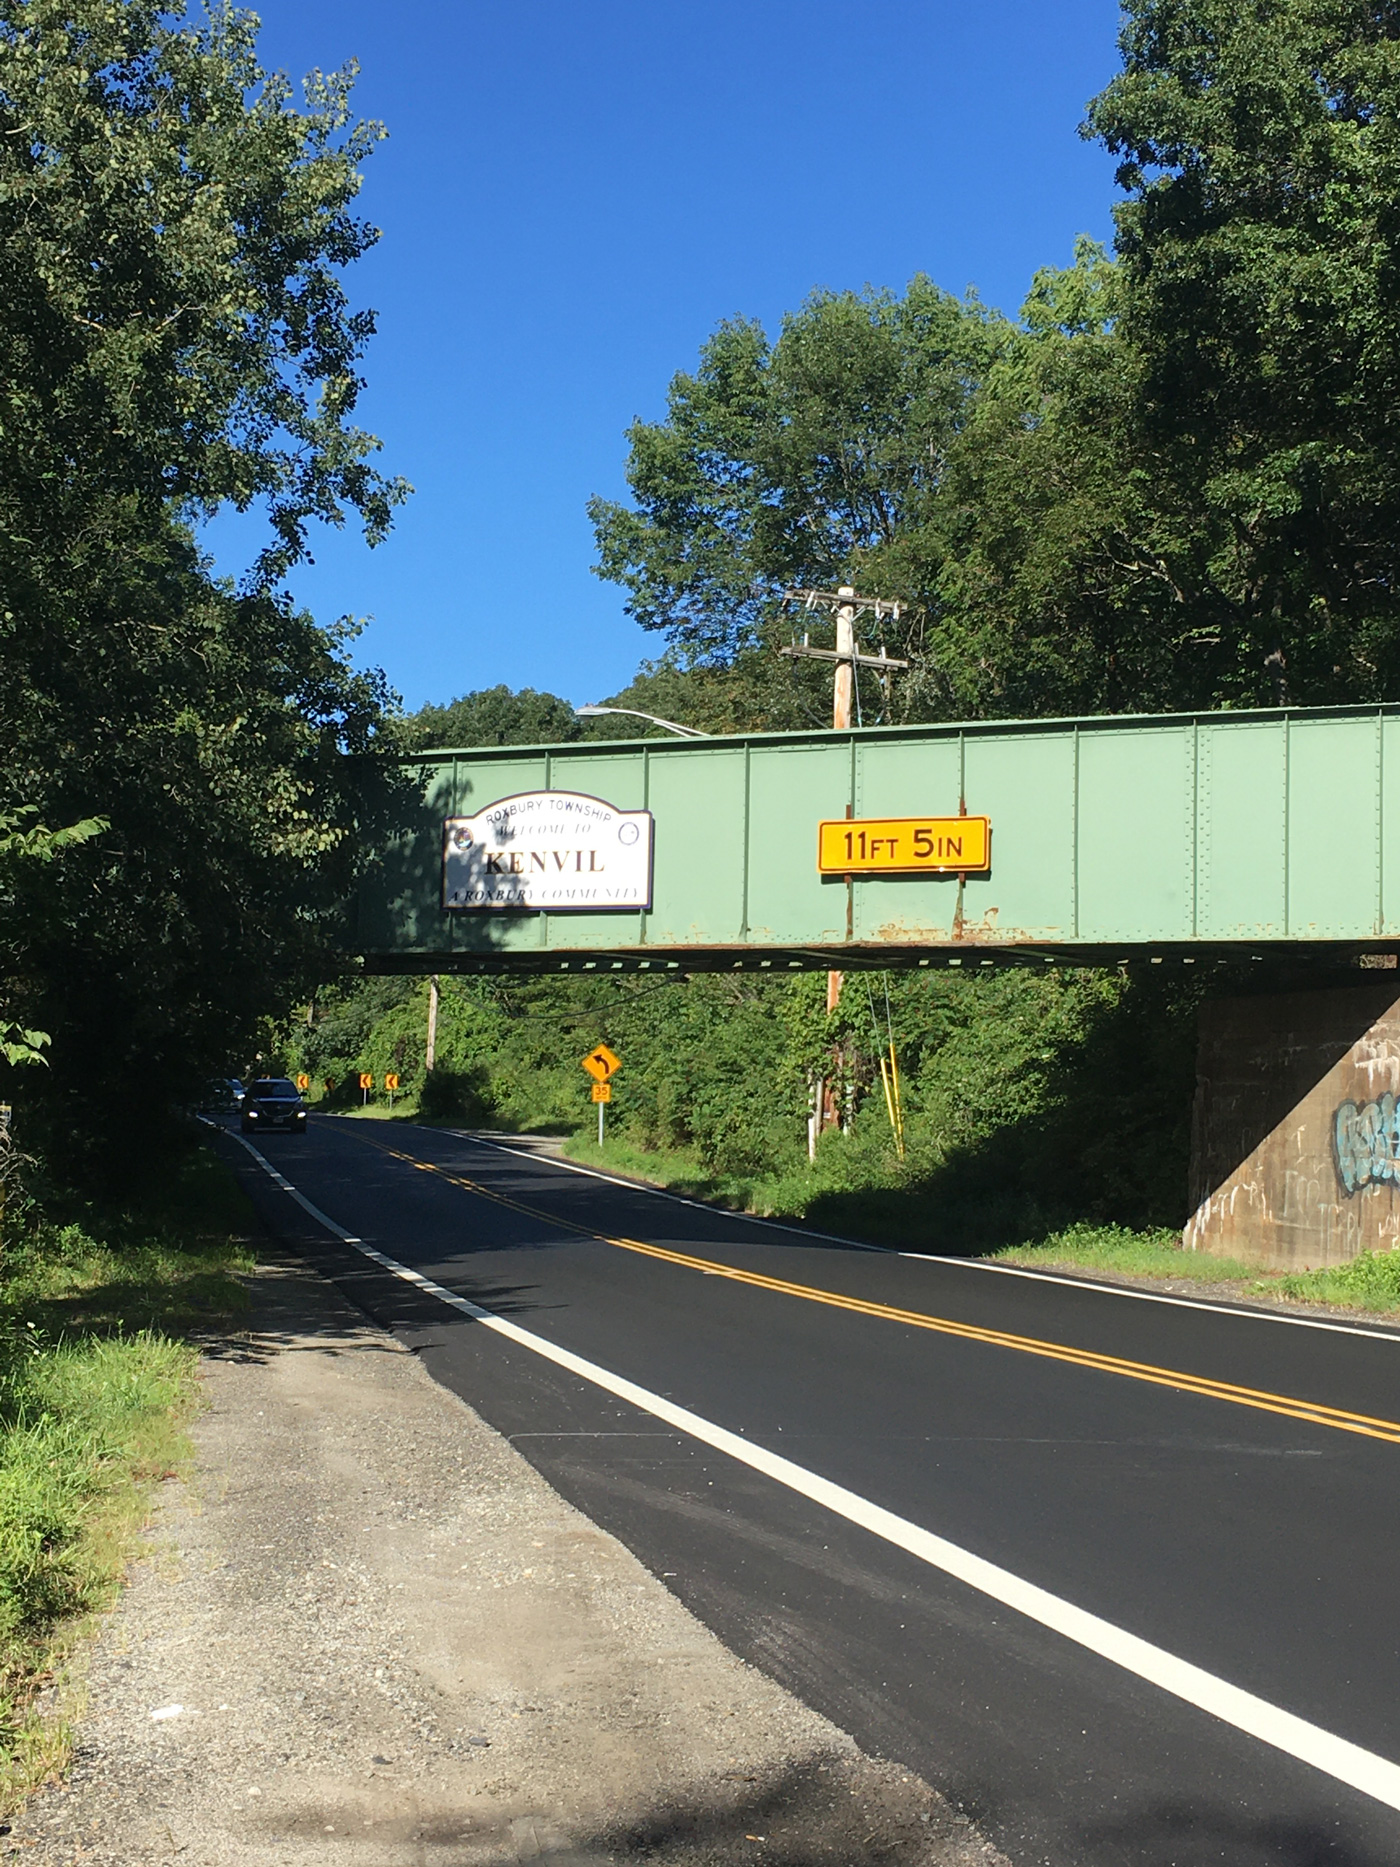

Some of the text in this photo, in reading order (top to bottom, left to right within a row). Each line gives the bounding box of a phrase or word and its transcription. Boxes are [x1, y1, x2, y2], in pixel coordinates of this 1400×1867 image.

[486, 799, 612, 825] ROXBURY TOWNSHIP
[499, 823, 592, 837] WELCOME TO
[484, 850, 605, 875] KENVIL
[449, 887, 638, 902] A ROXBURY COMMUNITY
[595, 1086, 608, 1096] 35
